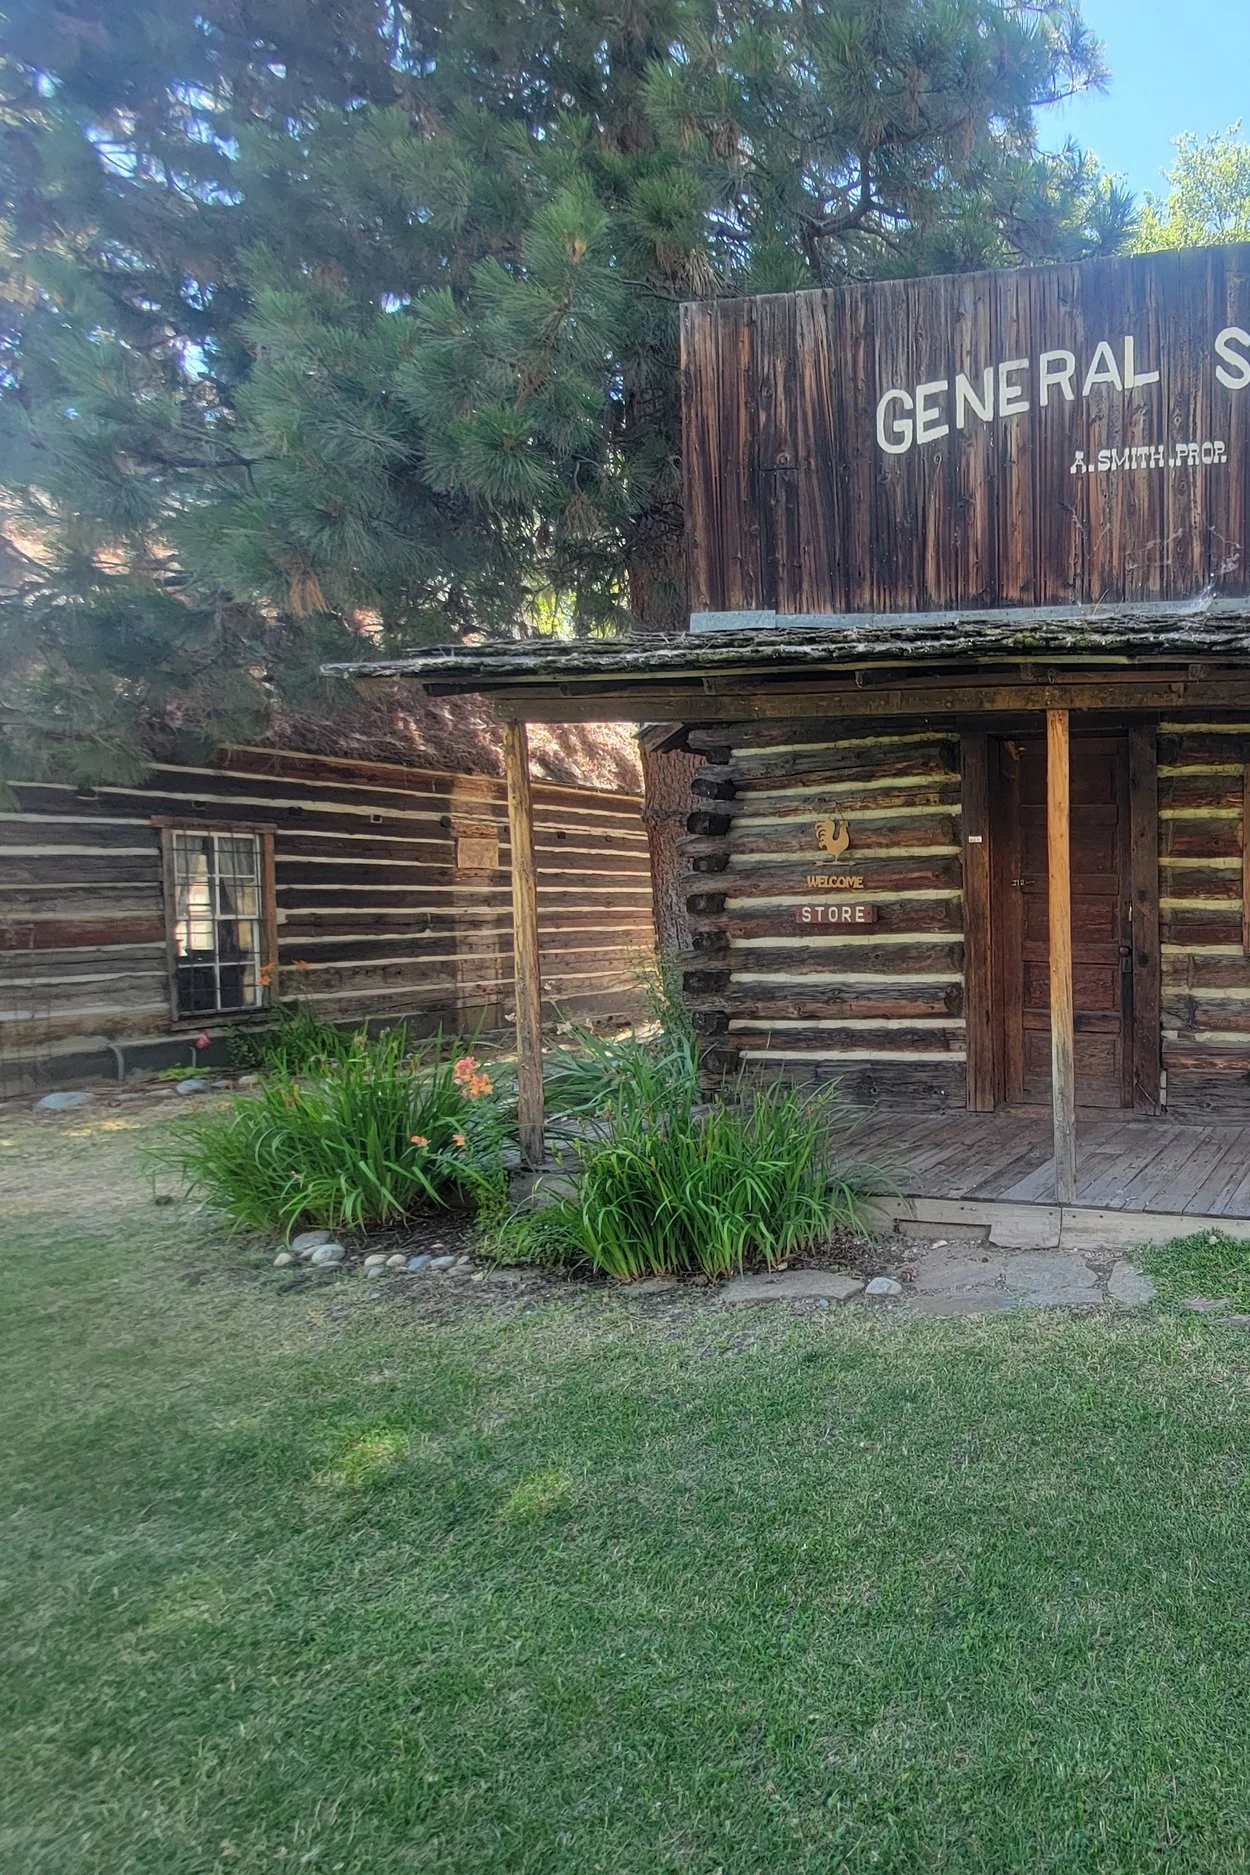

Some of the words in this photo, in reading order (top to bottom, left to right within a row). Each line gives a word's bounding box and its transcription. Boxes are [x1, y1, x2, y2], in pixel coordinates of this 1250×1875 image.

[876, 336, 1159, 454] GENERAL
[806, 875, 864, 889] WELCOME
[802, 906, 865, 923] STORE
